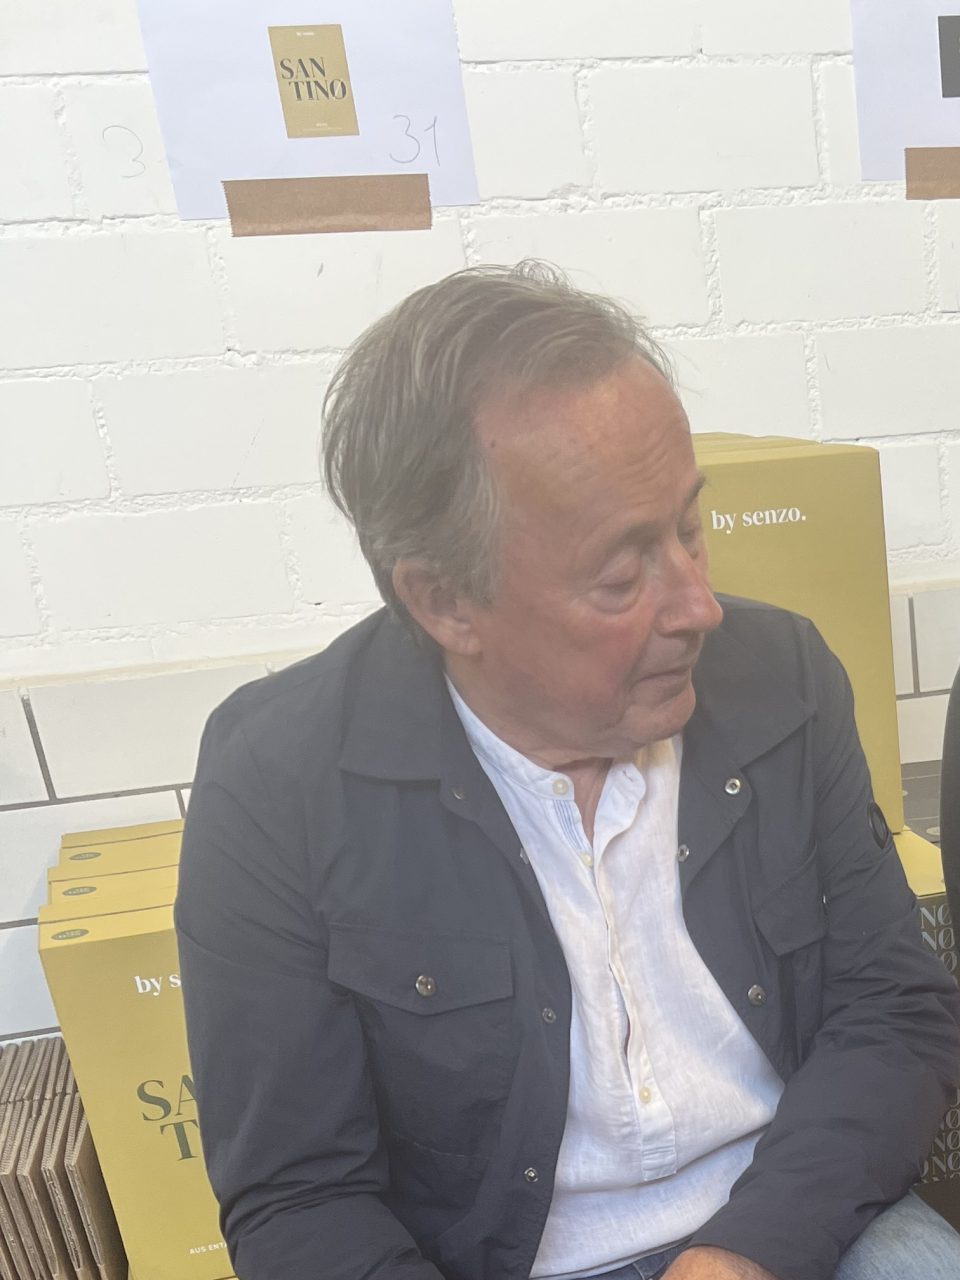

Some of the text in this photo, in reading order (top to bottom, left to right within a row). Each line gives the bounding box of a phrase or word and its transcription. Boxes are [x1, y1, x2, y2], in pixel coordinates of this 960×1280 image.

[280, 56, 326, 80] SAN
[389, 114, 441, 167] 31
[711, 507, 807, 534] by senzo.
[134, 974, 163, 996] by
[137, 1074, 198, 1122] SA
